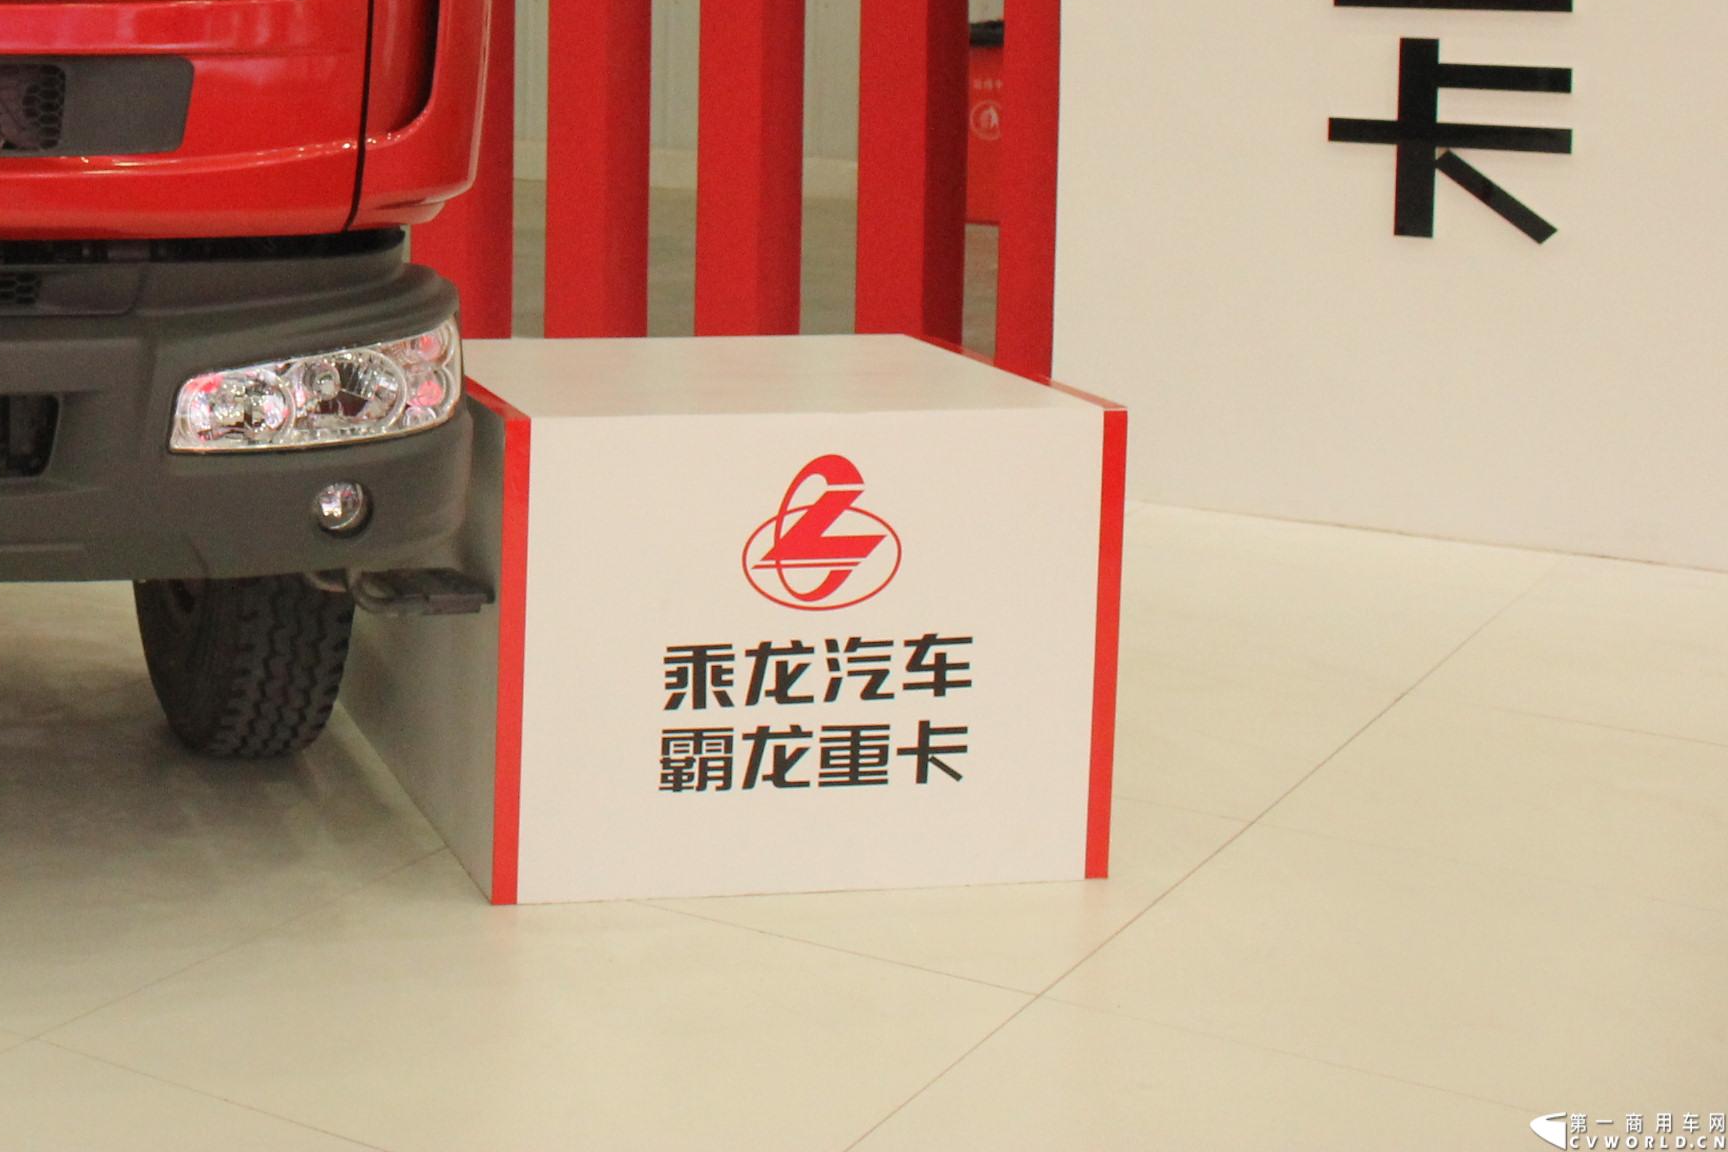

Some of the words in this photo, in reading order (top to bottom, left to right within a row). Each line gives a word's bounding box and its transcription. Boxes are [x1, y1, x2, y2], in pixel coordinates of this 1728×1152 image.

[663, 633, 973, 711] 乘龙汽车
[658, 719, 968, 793] 霸龙重卡
